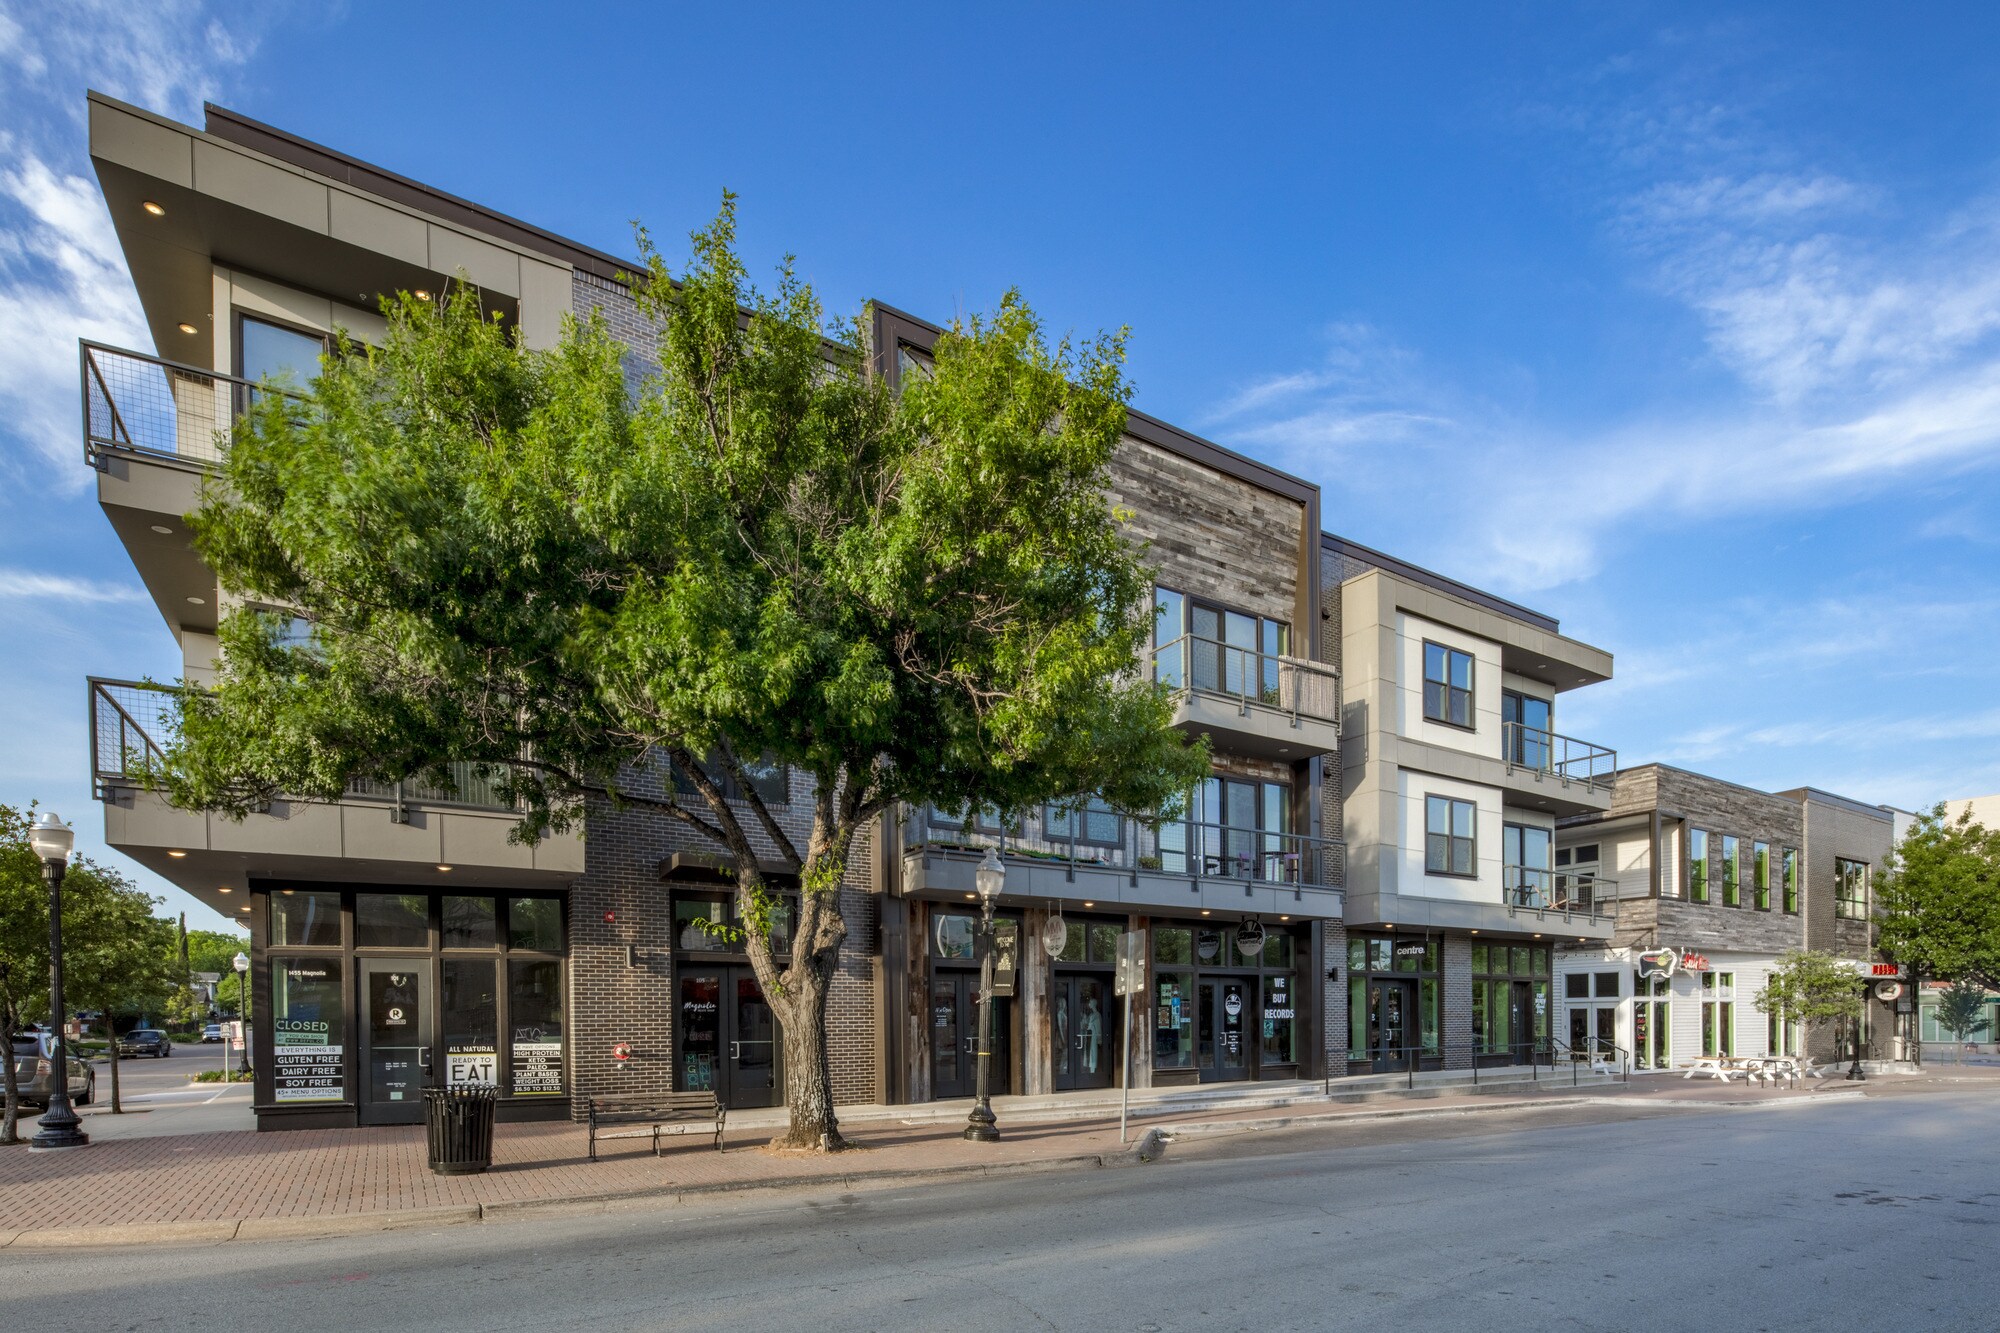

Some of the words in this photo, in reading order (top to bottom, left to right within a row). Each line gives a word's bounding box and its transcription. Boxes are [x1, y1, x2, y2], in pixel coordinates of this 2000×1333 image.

[1274, 978, 1285, 987] WE
[1272, 993, 1286, 1003] BUY
[684, 1001, 717, 1012] Magnolia
[1264, 1009, 1295, 1019] RECORDS
[276, 1020, 328, 1031] CLOSED
[277, 1056, 313, 1064] GLUTEN
[316, 1055, 340, 1063] FREE
[312, 1067, 336, 1075] FREE
[452, 1064, 492, 1081] EAT
[286, 1079, 306, 1087] SOY
